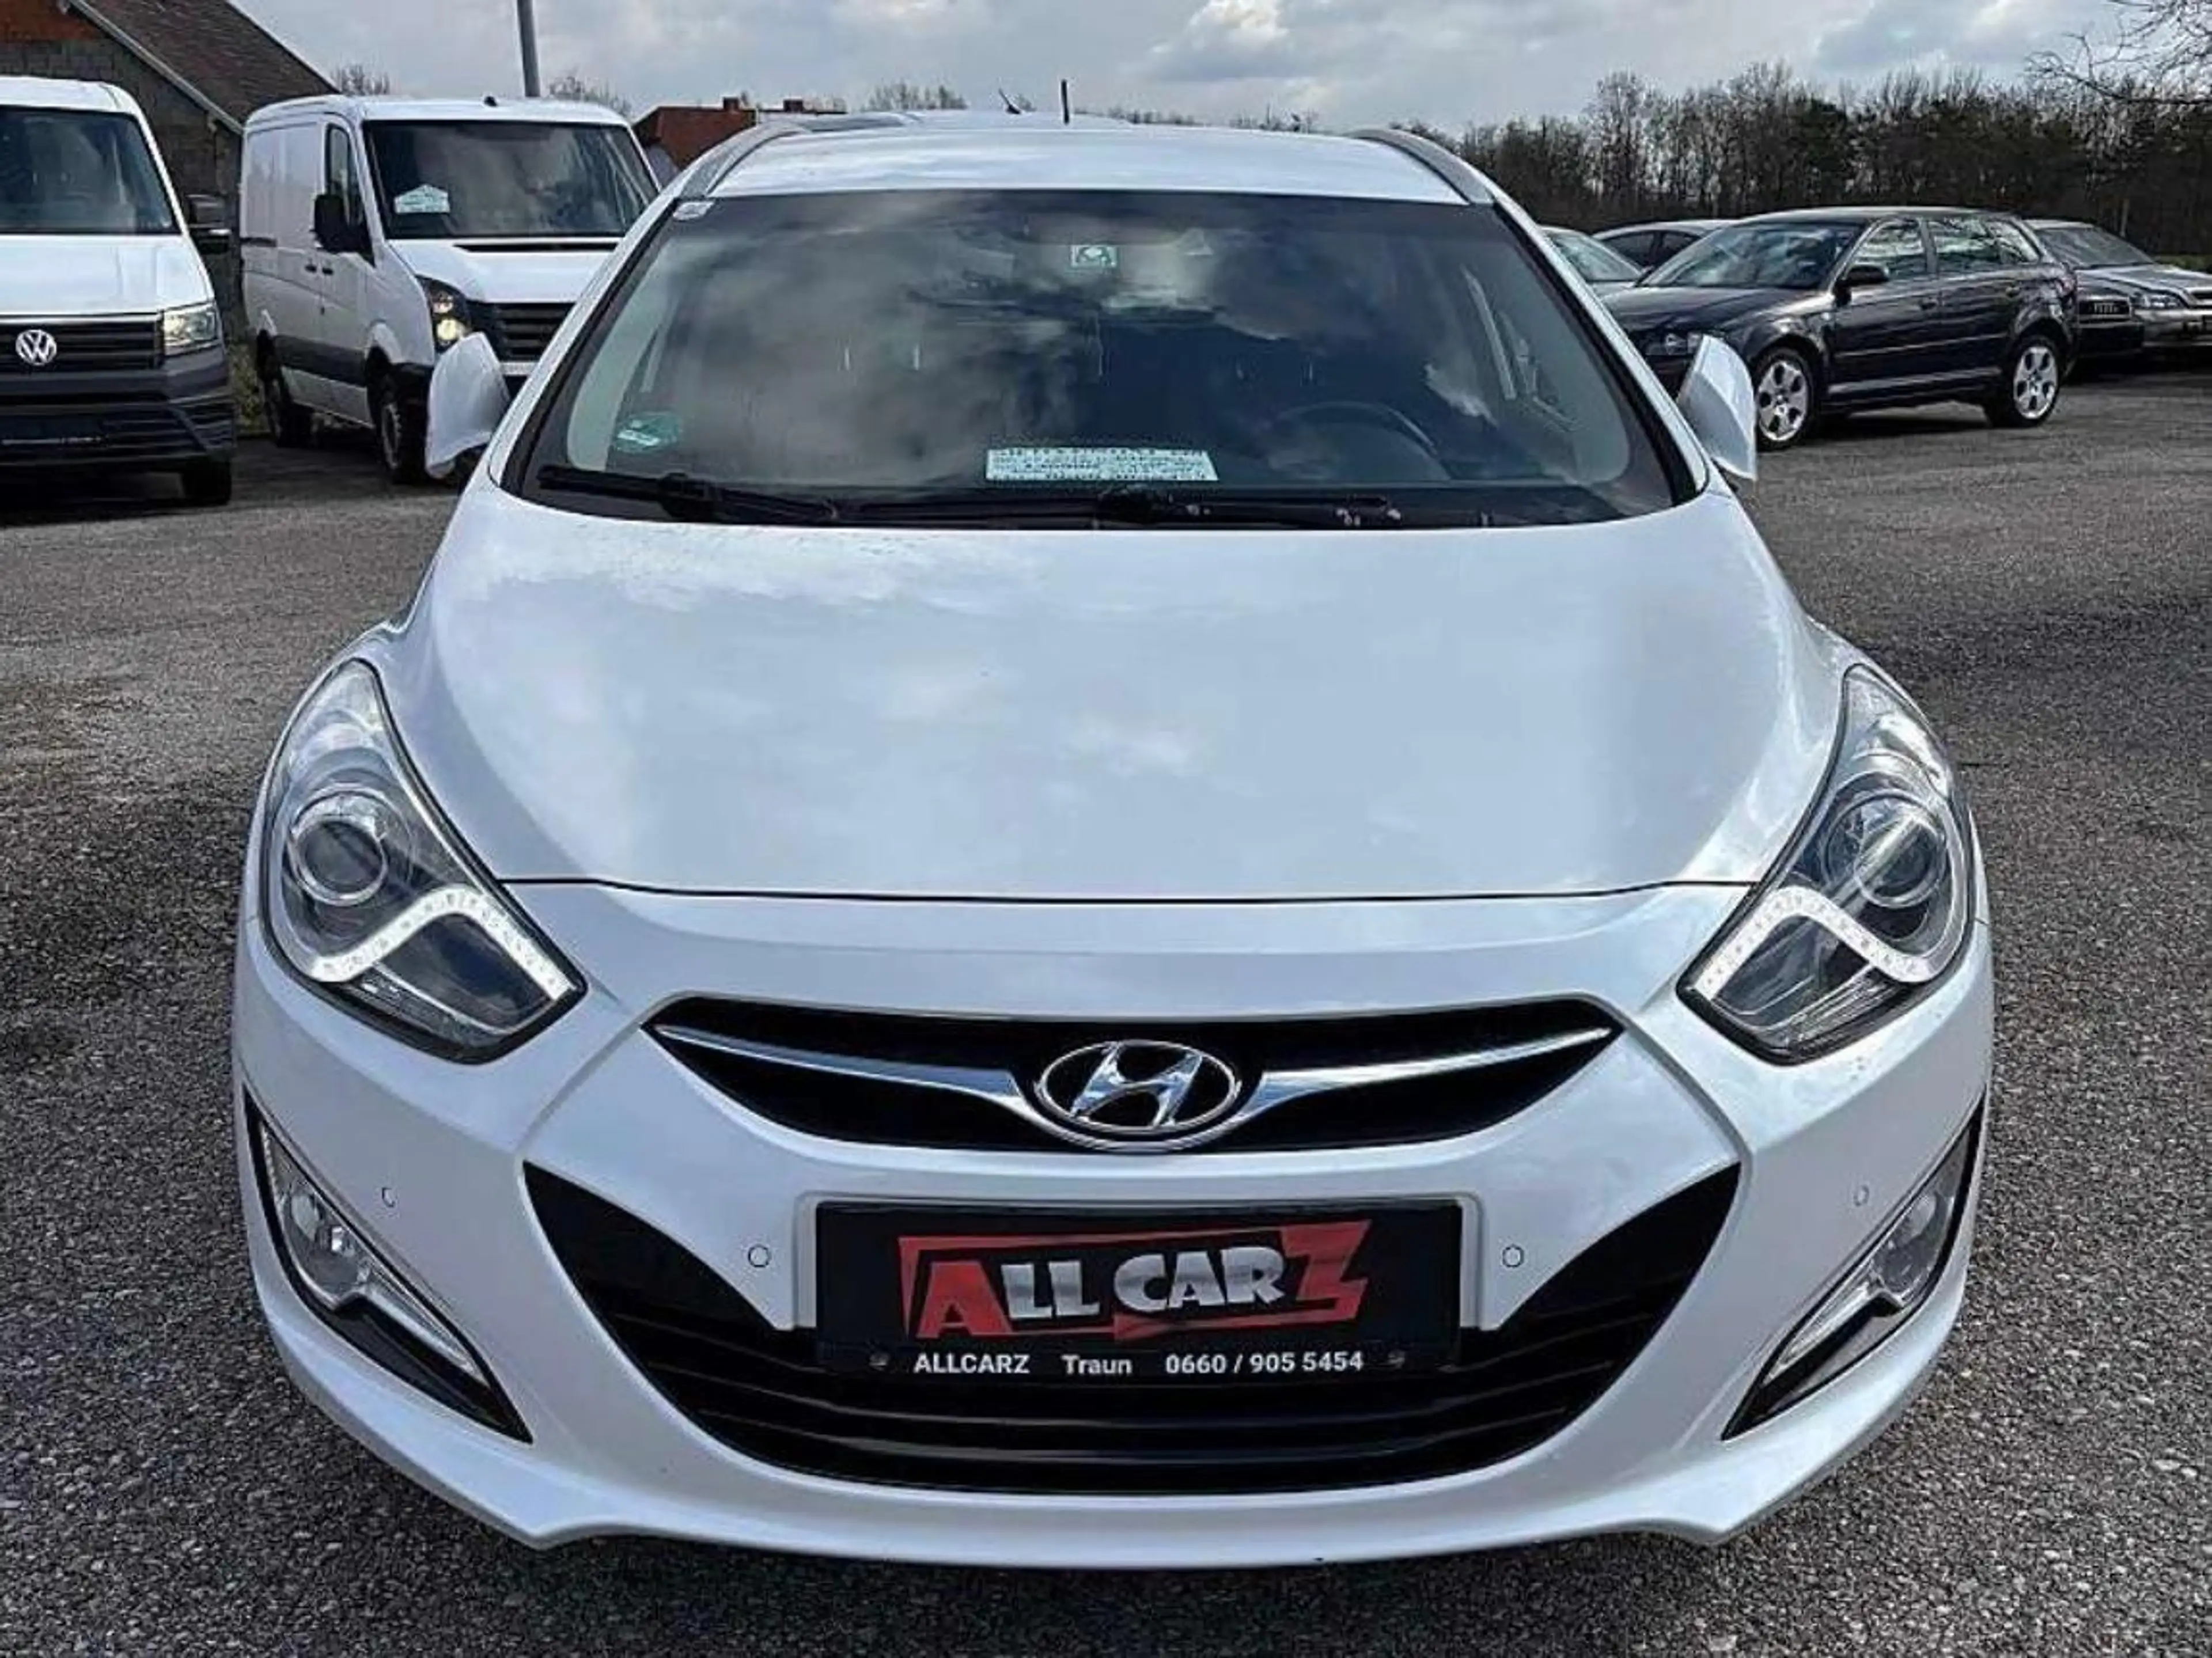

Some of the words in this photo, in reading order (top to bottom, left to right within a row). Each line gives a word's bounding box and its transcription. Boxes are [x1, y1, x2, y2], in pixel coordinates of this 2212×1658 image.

[916, 1259, 1100, 1339] ALL
[914, 1353, 1031, 1374] ALLCARZ
[1061, 1355, 1133, 1375] Traun
[1165, 1353, 1226, 1374] 0660
[1233, 1355, 1244, 1374] /
[1249, 1353, 1295, 1373] 905
[1302, 1350, 1364, 1372] 5454
